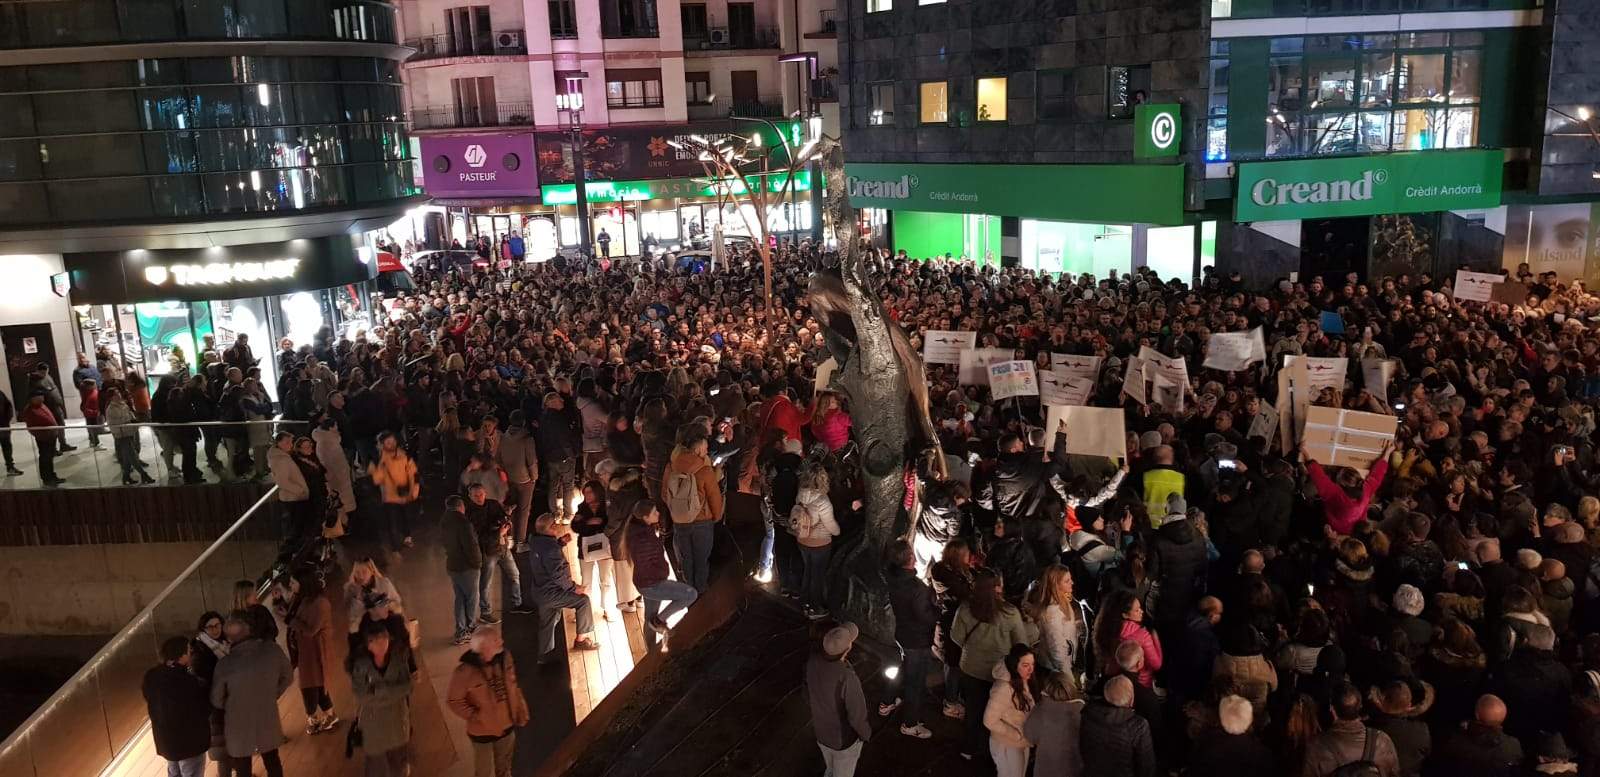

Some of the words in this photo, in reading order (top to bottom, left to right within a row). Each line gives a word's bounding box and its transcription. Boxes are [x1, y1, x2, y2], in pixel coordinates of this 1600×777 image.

[459, 172, 496, 182] PASTEUR
[1405, 187, 1437, 198] Crèdit
[1440, 185, 1482, 196] Andorrà
